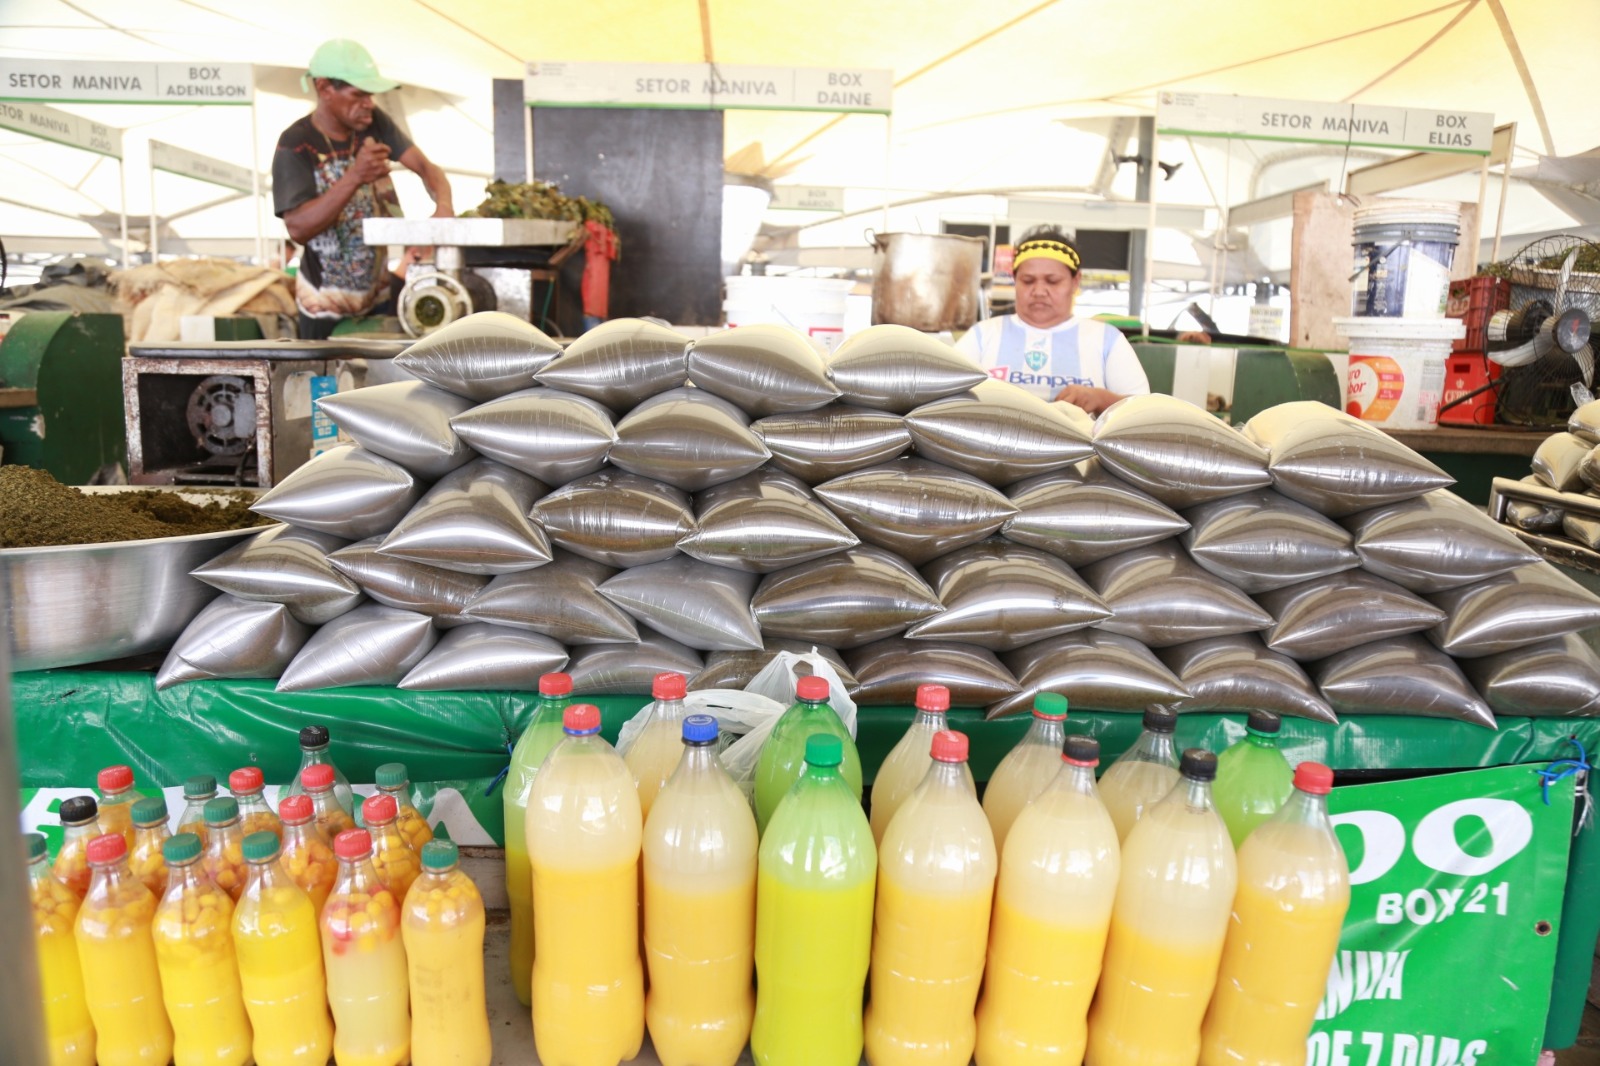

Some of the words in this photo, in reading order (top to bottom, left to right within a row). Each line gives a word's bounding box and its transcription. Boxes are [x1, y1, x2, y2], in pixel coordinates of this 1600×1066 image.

[189, 67, 221, 80] BOX
[828, 73, 862, 87] BOX
[9, 73, 62, 89] SETOR
[73, 75, 142, 91] MANIVA
[635, 78, 691, 94] SETOR
[703, 79, 777, 96] MANIVA
[166, 85, 247, 97] ADENILSON
[817, 91, 873, 106] DAINE
[29, 113, 71, 136] MANIVA
[1261, 112, 1312, 130] SETOR
[1322, 116, 1390, 135] MANIVA
[1437, 114, 1468, 129] BOX
[1429, 132, 1473, 147] ELIAS
